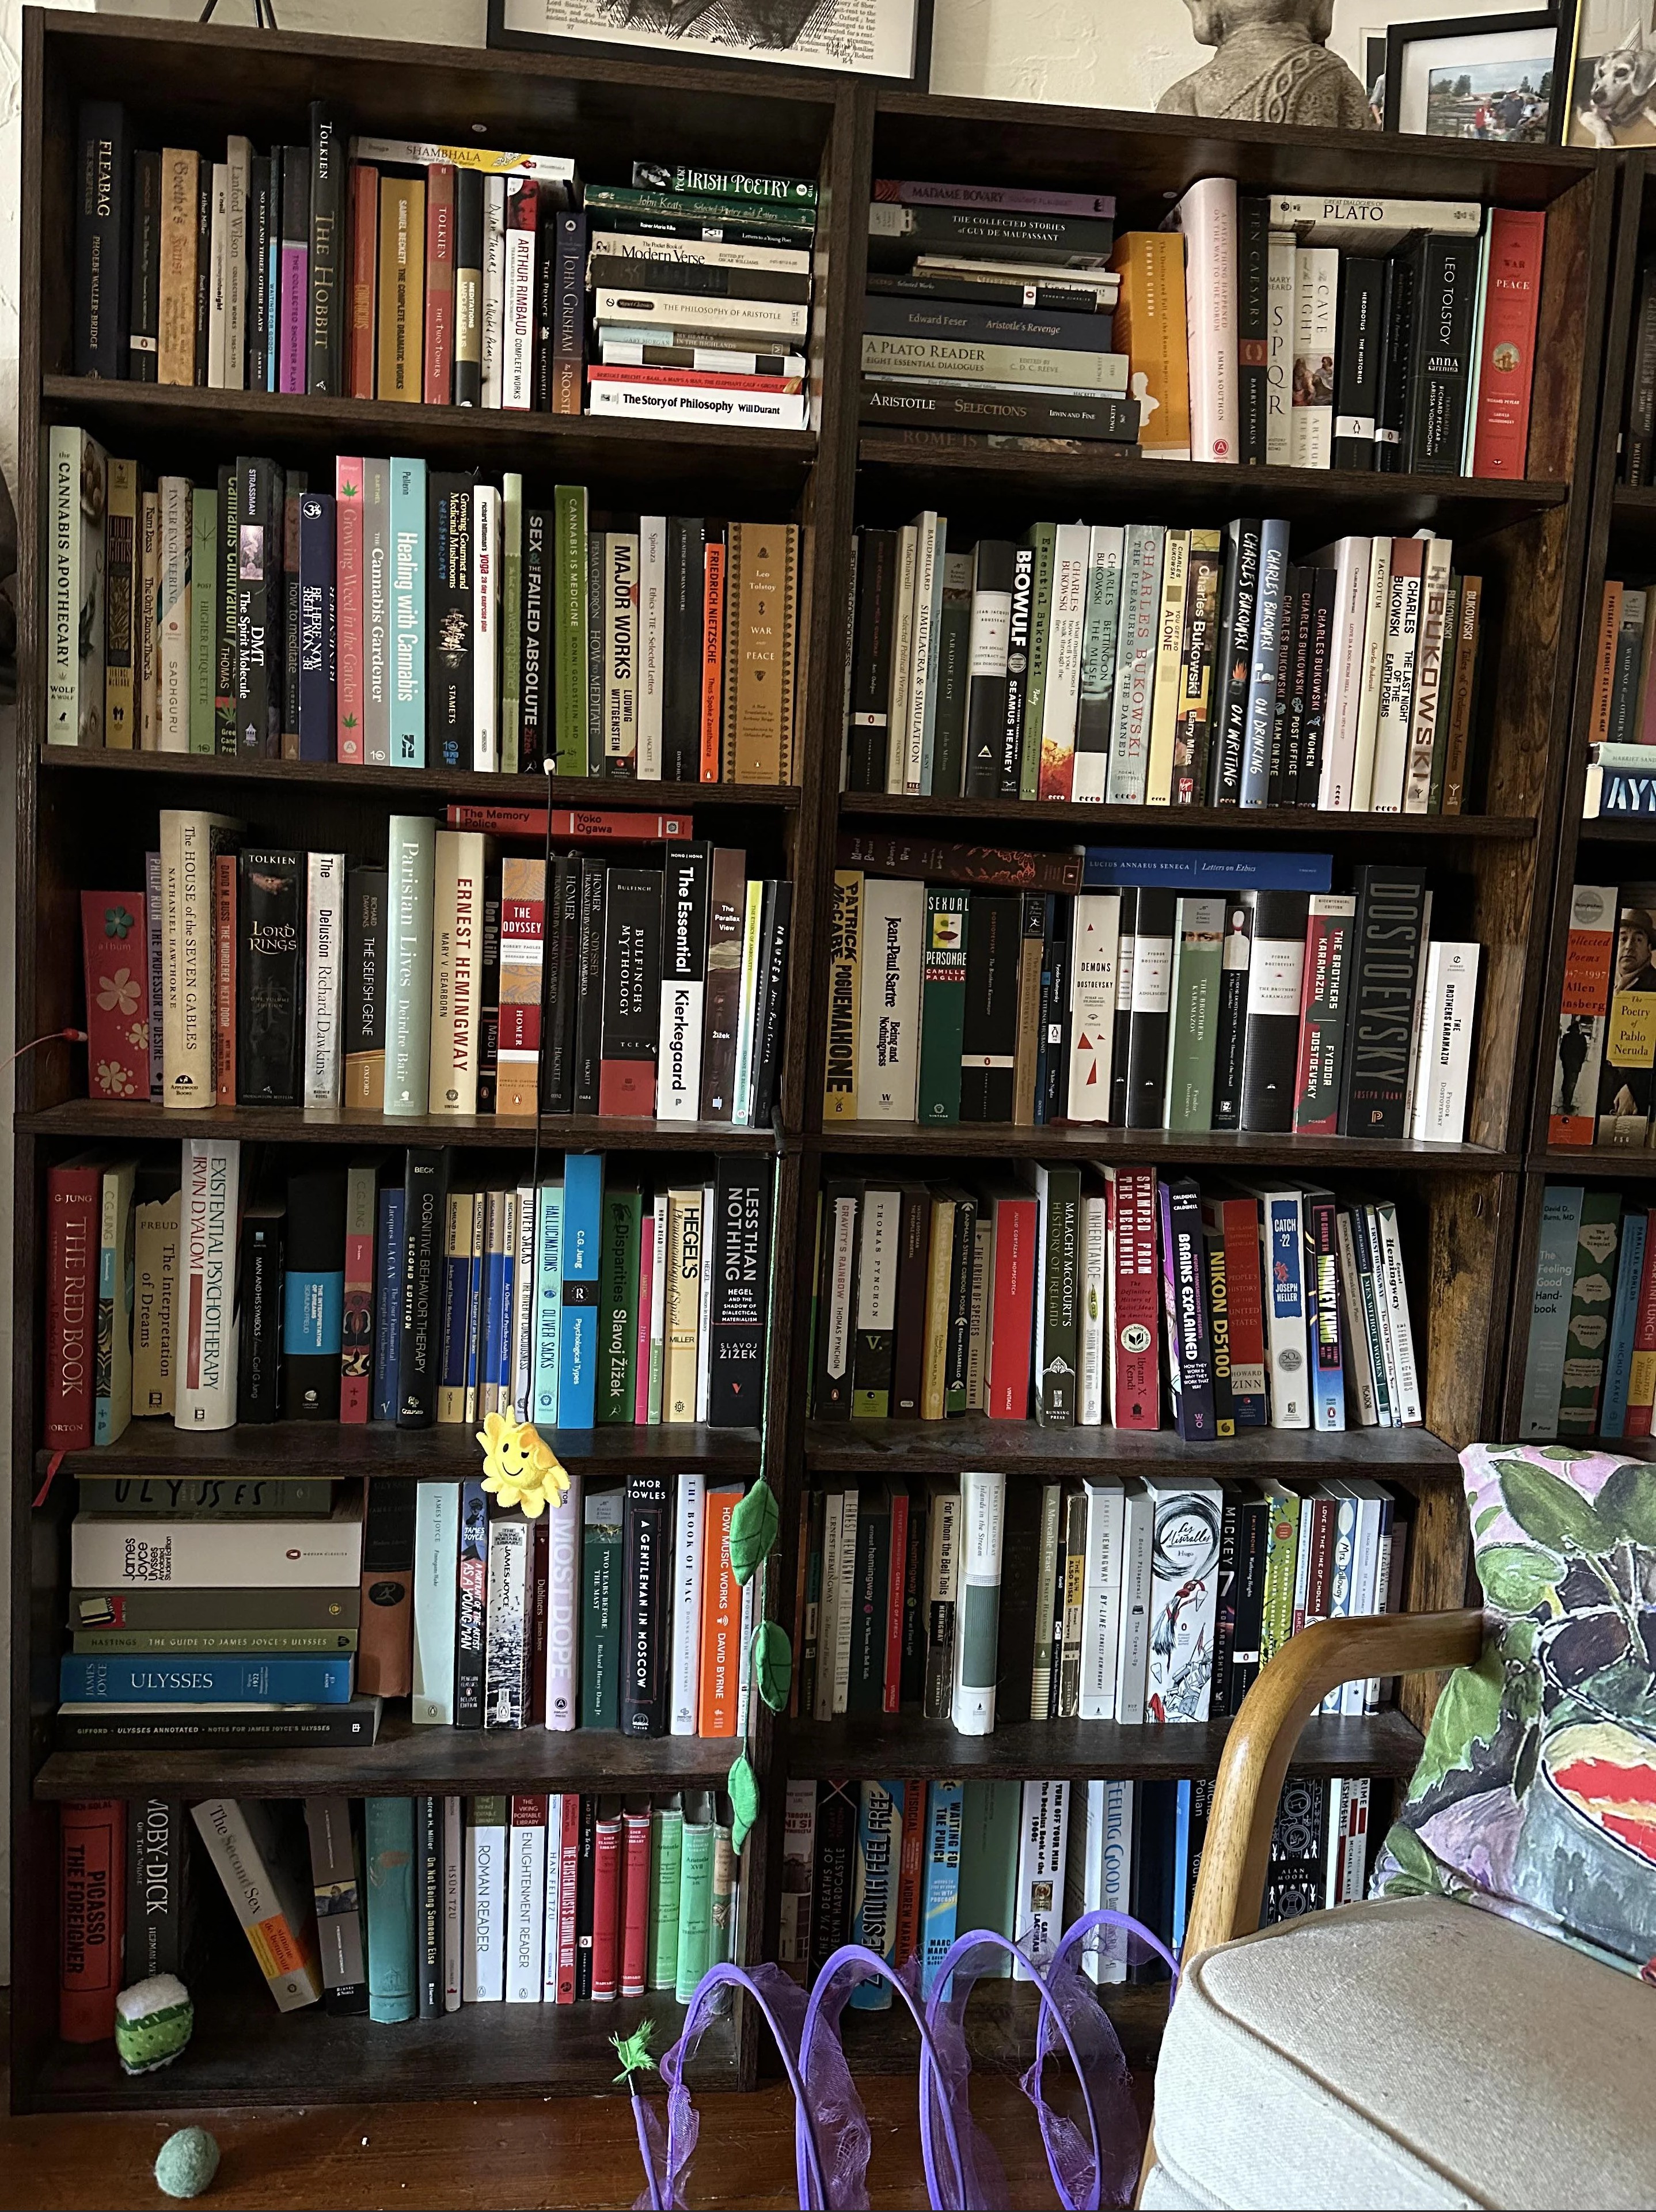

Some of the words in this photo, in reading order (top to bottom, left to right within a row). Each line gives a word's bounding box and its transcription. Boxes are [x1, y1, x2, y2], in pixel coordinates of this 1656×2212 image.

[320, 122, 332, 179] TOLKIEN
[98, 139, 112, 217] FLEABAG
[687, 169, 727, 192] IRISH
[731, 174, 791, 197] POETRY
[1324, 204, 1384, 221] PLATO
[316, 213, 334, 256] THE
[518, 238, 530, 282] ARTHUR
[1445, 257, 1455, 283] LEO
[314, 265, 333, 348] HOBBIT
[515, 284, 528, 335] RIMBAUD
[1440, 287, 1454, 345] TOLSTOY
[515, 339, 523, 374] COMPLETE
[867, 342, 876, 354] A
[881, 343, 925, 356] PLATO
[930, 345, 985, 361] READER
[514, 376, 522, 400] WORKS
[624, 394, 640, 404] The
[642, 394, 666, 408] Story
[667, 397, 677, 407] of
[679, 398, 733, 413] Philosophy
[738, 403, 753, 412] Will
[754, 404, 780, 415] Durant
[870, 393, 936, 411] ARISTOTLE
[955, 400, 1027, 416] SELECTIONS
[59, 462, 70, 548] CANNABIS
[529, 516, 542, 552] SEX
[393, 532, 418, 591] Healing
[613, 545, 631, 609] MAJOR
[710, 550, 719, 608] FRIEDRICH
[1240, 533, 1258, 587] CHARLES
[241, 591, 250, 612] The
[527, 574, 543, 632] FAILED
[1012, 551, 1032, 646] BEOWULF
[1137, 540, 1156, 638] CHARLES
[1193, 565, 1209, 616] Charles
[1376, 559, 1385, 608] FACTOTUM
[58, 555, 69, 668] APOTHECARY
[240, 616, 250, 648] Spirit
[396, 595, 418, 632] with
[1234, 591, 1255, 650] BUKOWSKI
[252, 625, 264, 666] DMT
[614, 614, 631, 680] WORKS
[707, 610, 717, 664] NIETZSCHE
[240, 651, 248, 700] Molecule
[397, 633, 418, 702] Cannabis
[524, 636, 539, 726] ABSOLUTE
[1186, 621, 1206, 699] Bukowski
[1006, 681, 1017, 724] SEAMUS
[1129, 648, 1148, 758] BUKOWSKI
[1232, 704, 1242, 722] ON
[1002, 726, 1014, 773] HEANEY
[1224, 726, 1240, 787] WRITING
[1306, 733, 1315, 767] WOMEN
[185, 826, 195, 847] The
[464, 810, 485, 818] The
[489, 811, 530, 822] Memory
[464, 819, 497, 829] Police
[577, 814, 602, 824] Yoko
[577, 822, 613, 835] Ogawa
[185, 851, 196, 902] HOUSE
[249, 855, 296, 865] TOLKIEN
[399, 839, 419, 925] Parisian
[679, 867, 694, 898] The
[928, 896, 970, 911] SEXUAL
[186, 906, 193, 916] of
[456, 878, 472, 950] ERNEST
[503, 921, 542, 934] ODYSSEY
[514, 907, 531, 919] THE
[675, 901, 694, 973] Essential
[884, 917, 902, 971] Jean-Paul
[926, 951, 967, 966] PERSONAE
[186, 939, 196, 988] SEVEN
[399, 935, 417, 987] Lives
[619, 925, 631, 1015] MYTHOLOGY
[633, 929, 643, 1013] BULFINCH'S
[1081, 962, 1111, 972] DEMONS
[884, 973, 897, 1008] Sartre
[1077, 980, 1113, 989] DOSTOEVSKY
[1355, 883, 1420, 1084] DOSTOEVSKY
[186, 992, 196, 1050] GABLES
[397, 1000, 411, 1047] Deirdre
[453, 957, 472, 1071] HEMINGWAY
[1621, 1006, 1650, 1019] Poetry
[671, 990, 690, 1091] Kierkegaard
[1614, 1045, 1648, 1055] Neruda
[1620, 1031, 1646, 1041] Pablo
[396, 1052, 409, 1083] Bair
[208, 1158, 227, 1255] EXISTENTIAL
[1120, 1177, 1132, 1200] THE
[1137, 1175, 1152, 1238] STAMPED
[66, 1216, 86, 1269] THE
[140, 1221, 178, 1230] FREUD
[544, 1205, 557, 1273] HALLUCINATIONS
[682, 1208, 699, 1279] HEGEL'S
[725, 1187, 742, 1281] NOTHING
[875, 1204, 884, 1253] THOMAS
[1064, 1202, 1074, 1258] MALACHY
[1119, 1209, 1134, 1275] BEGINNING
[1274, 1219, 1296, 1232] CATCH
[1137, 1242, 1152, 1275] FROM
[1177, 1233, 1192, 1282] BRAINS
[64, 1275, 85, 1323] RED
[872, 1261, 881, 1317] PYNCHON
[1062, 1261, 1072, 1327] McCOURT'S
[1210, 1251, 1226, 1314] NIKON
[1275, 1284, 1298, 1293] JOSEPH
[1277, 1293, 1298, 1302] HELLER
[1317, 1255, 1336, 1308] MONKEY
[1535, 1291, 1563, 1300] Hand-
[203, 1258, 223, 1391] PSYCHOTHERAPY
[1180, 1285, 1197, 1360] EXPLAINED
[1320, 1311, 1338, 1343] KING
[1534, 1304, 1556, 1314] book
[611, 1310, 627, 1354] Slavoj
[867, 1335, 883, 1350] V.
[1211, 1320, 1230, 1377] D5100
[62, 1327, 83, 1397] BOOK
[610, 1359, 625, 1397] Žižek
[1232, 1379, 1262, 1390] ZINN
[628, 1491, 666, 1500] TOWLES
[633, 1479, 661, 1488] AMOR
[942, 1516, 954, 1541] Whom
[944, 1501, 955, 1515] For
[941, 1543, 952, 1556] the
[1222, 1507, 1235, 1565] MICKEY
[122, 1538, 136, 1581] James
[136, 1541, 147, 1581] Joyce
[639, 1534, 650, 1607] GENTLEMAN
[941, 1558, 951, 1574] Bell
[1219, 1571, 1235, 1598] 7
[1334, 1565, 1346, 1598] Dalloway
[639, 1614, 648, 1625] IN
[637, 1631, 647, 1689] MOSCOW
[716, 1633, 727, 1663] DAVID
[131, 1673, 213, 1689] ULYSSES
[715, 1665, 726, 1699] BYRNE
[936, 1808, 947, 1826] THE
[1054, 1784, 1063, 1807] TURN
[948, 1802, 961, 1847] WAITING
[1031, 1816, 1039, 1842] 1960s
[934, 1830, 946, 1863] PUNCH
[947, 1851, 958, 1868] FOR
[1051, 1850, 1059, 1872] MIND
[521, 1832, 533, 1926] ENLIGHTENMENT
[86, 1870, 106, 1945] PICASSO
[519, 1928, 530, 1968] READER
